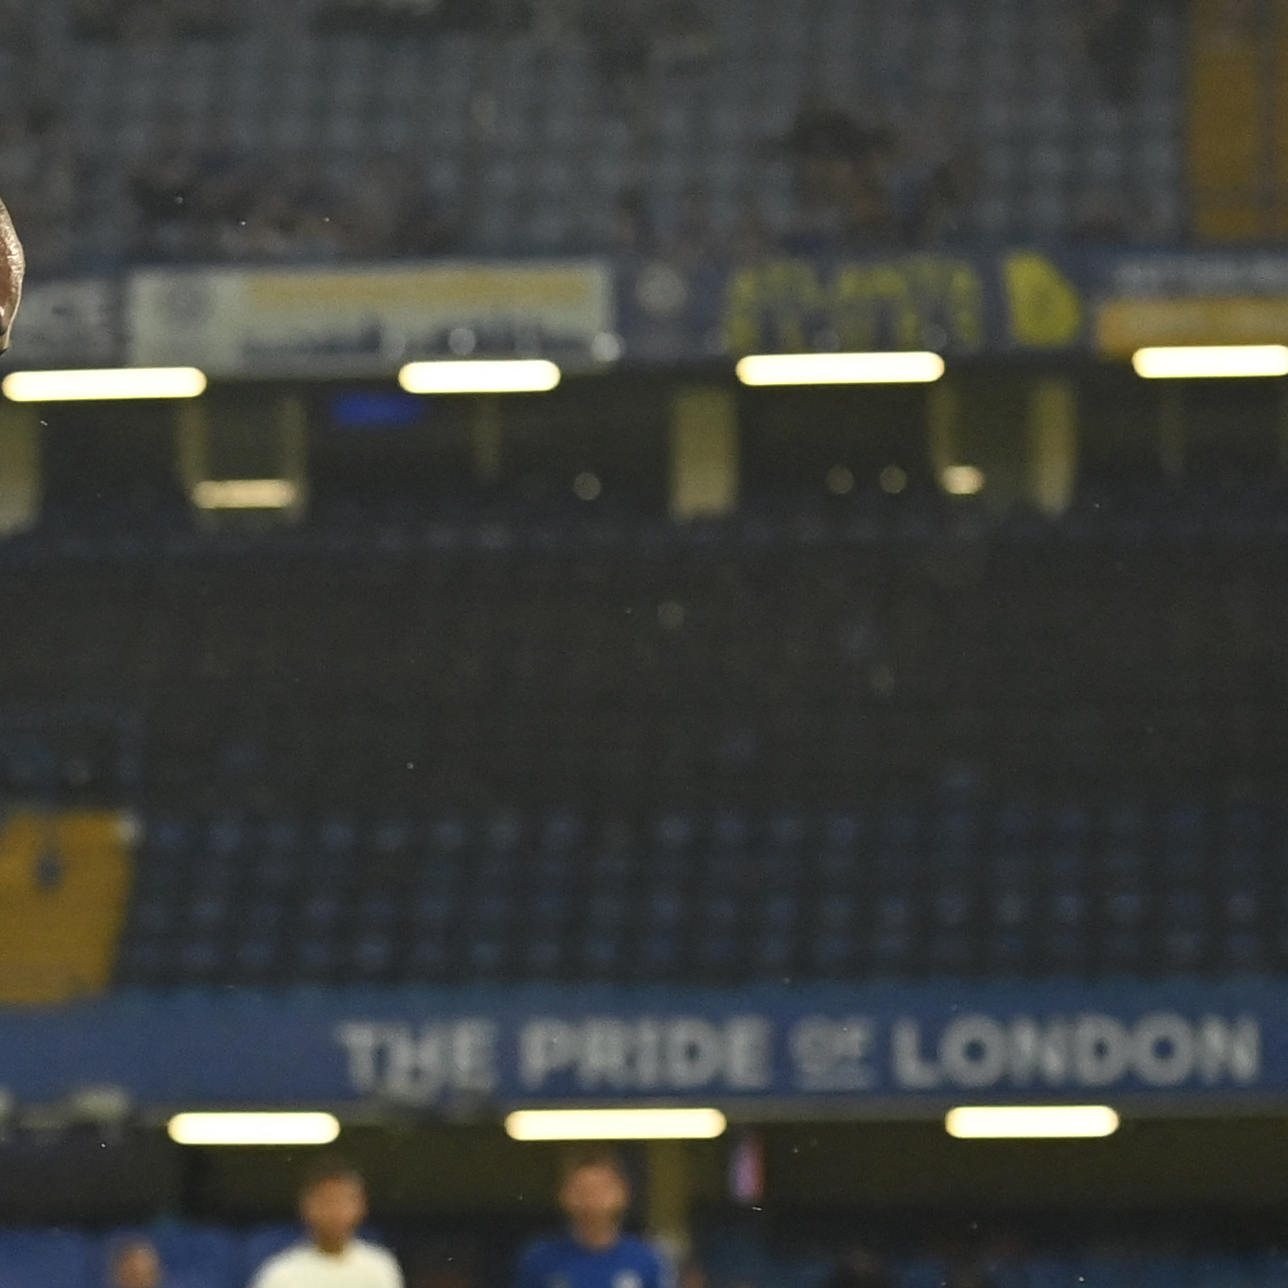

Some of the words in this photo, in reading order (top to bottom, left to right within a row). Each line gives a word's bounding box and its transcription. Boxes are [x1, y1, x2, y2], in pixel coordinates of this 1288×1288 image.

[333, 1018, 497, 1090] THE
[520, 1016, 771, 1089] PRIDE
[892, 1013, 1261, 1086] LONDON
